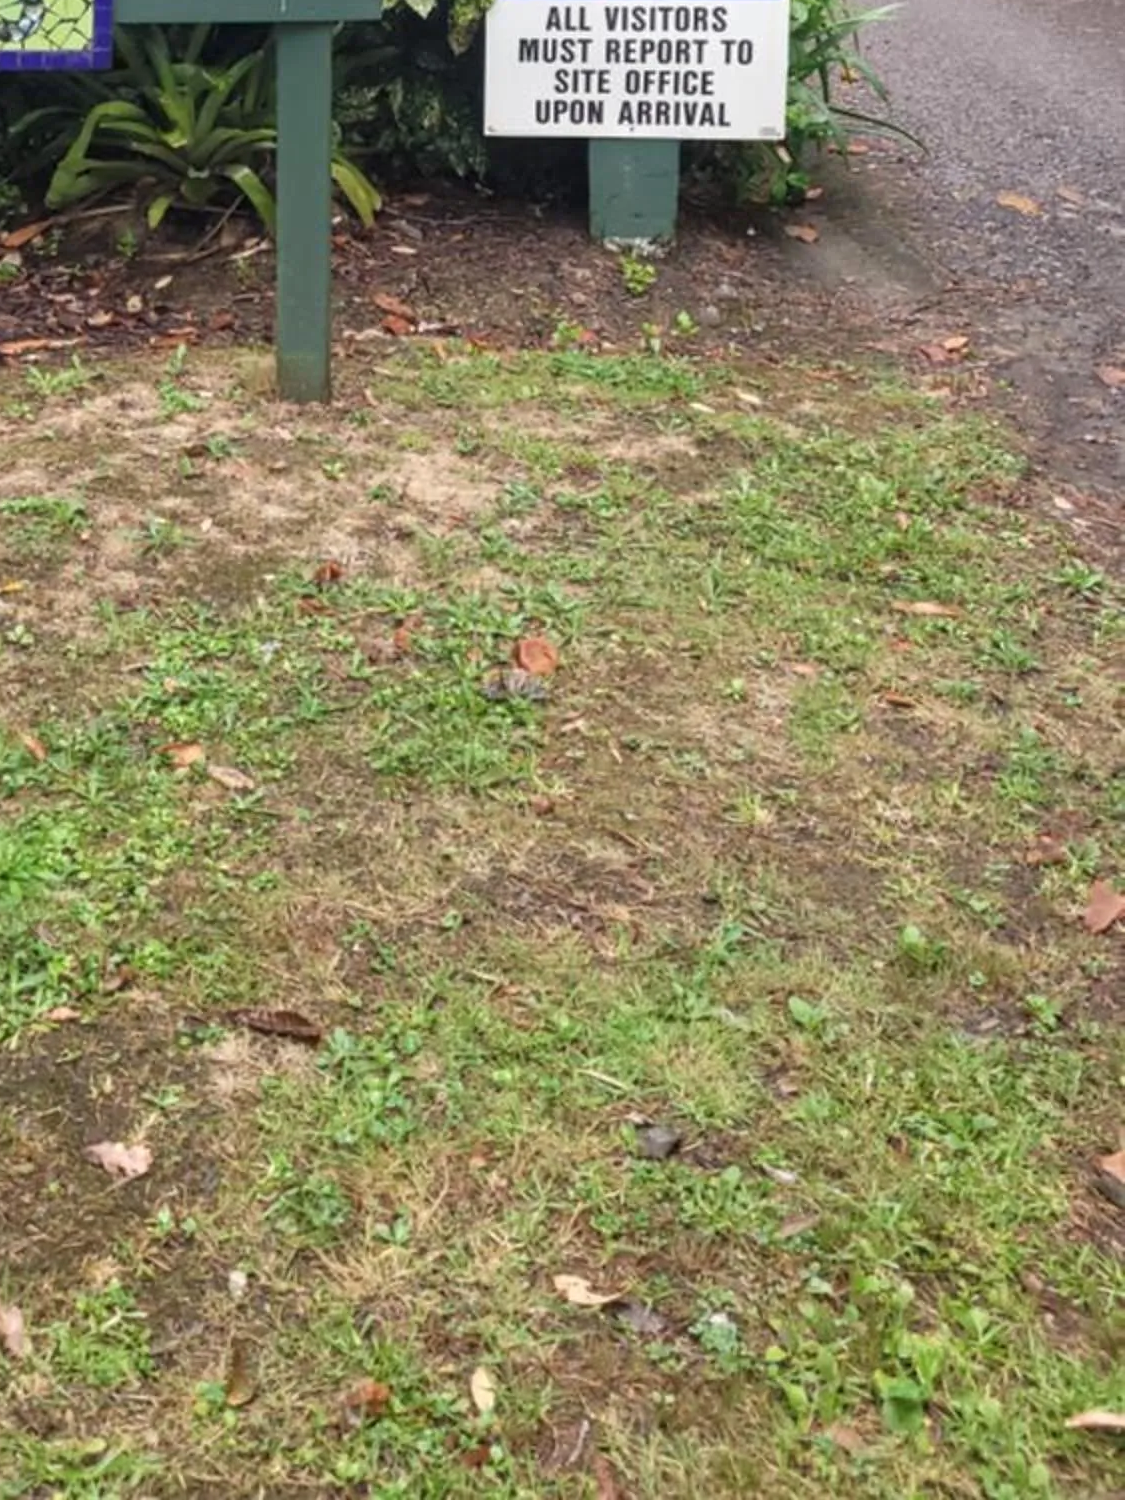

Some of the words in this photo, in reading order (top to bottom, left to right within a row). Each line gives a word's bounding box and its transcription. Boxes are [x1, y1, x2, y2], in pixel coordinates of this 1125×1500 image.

[546, 6, 592, 32] ALL
[605, 6, 728, 32] VISITORS
[518, 38, 593, 64] MUST
[605, 39, 704, 65] REPORT
[721, 40, 754, 65] TO
[554, 70, 610, 95] SITE
[625, 71, 714, 95] OFFICE
[535, 100, 604, 125] UPON
[618, 101, 731, 127] ARRIVAL
